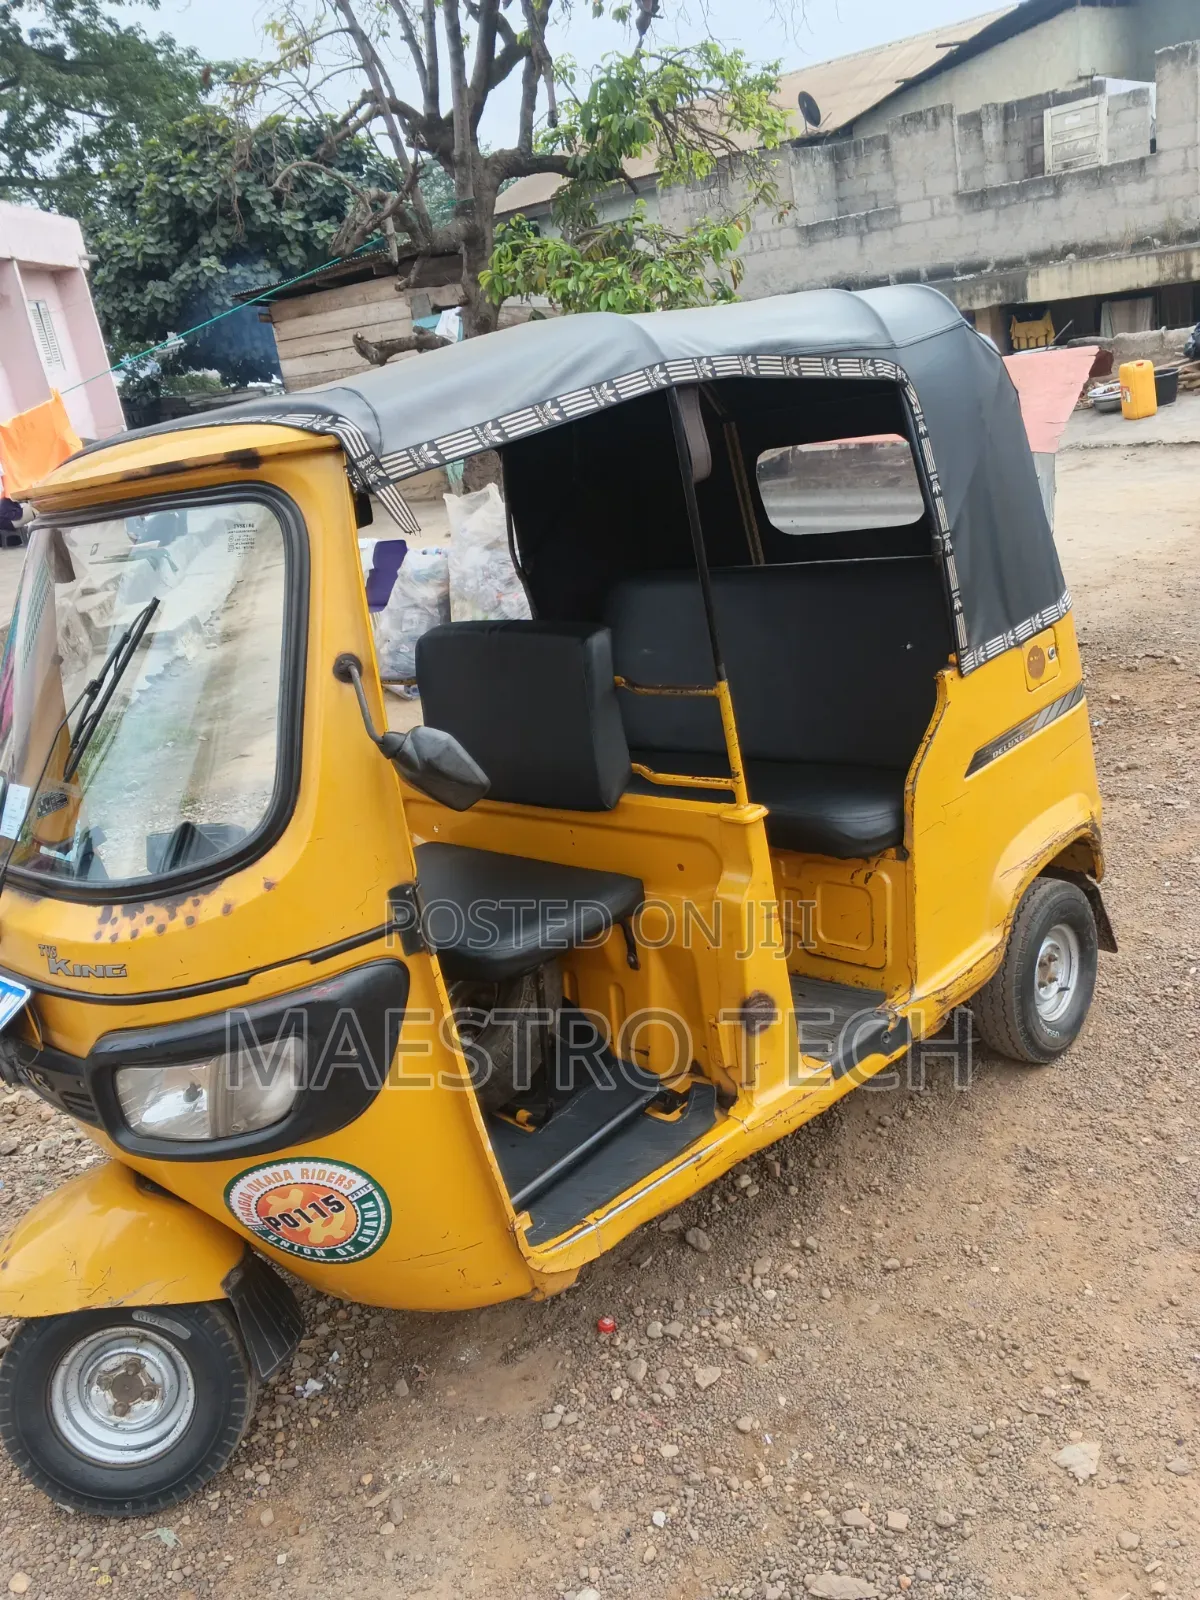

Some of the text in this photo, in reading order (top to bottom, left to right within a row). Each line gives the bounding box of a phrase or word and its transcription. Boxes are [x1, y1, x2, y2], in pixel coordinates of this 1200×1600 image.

[992, 733, 1025, 759] DELUXE
[38, 944, 58, 959] TVS
[300, 1167, 357, 1191] RIDERS
[267, 1199, 379, 1258] UNION OF GHANA
